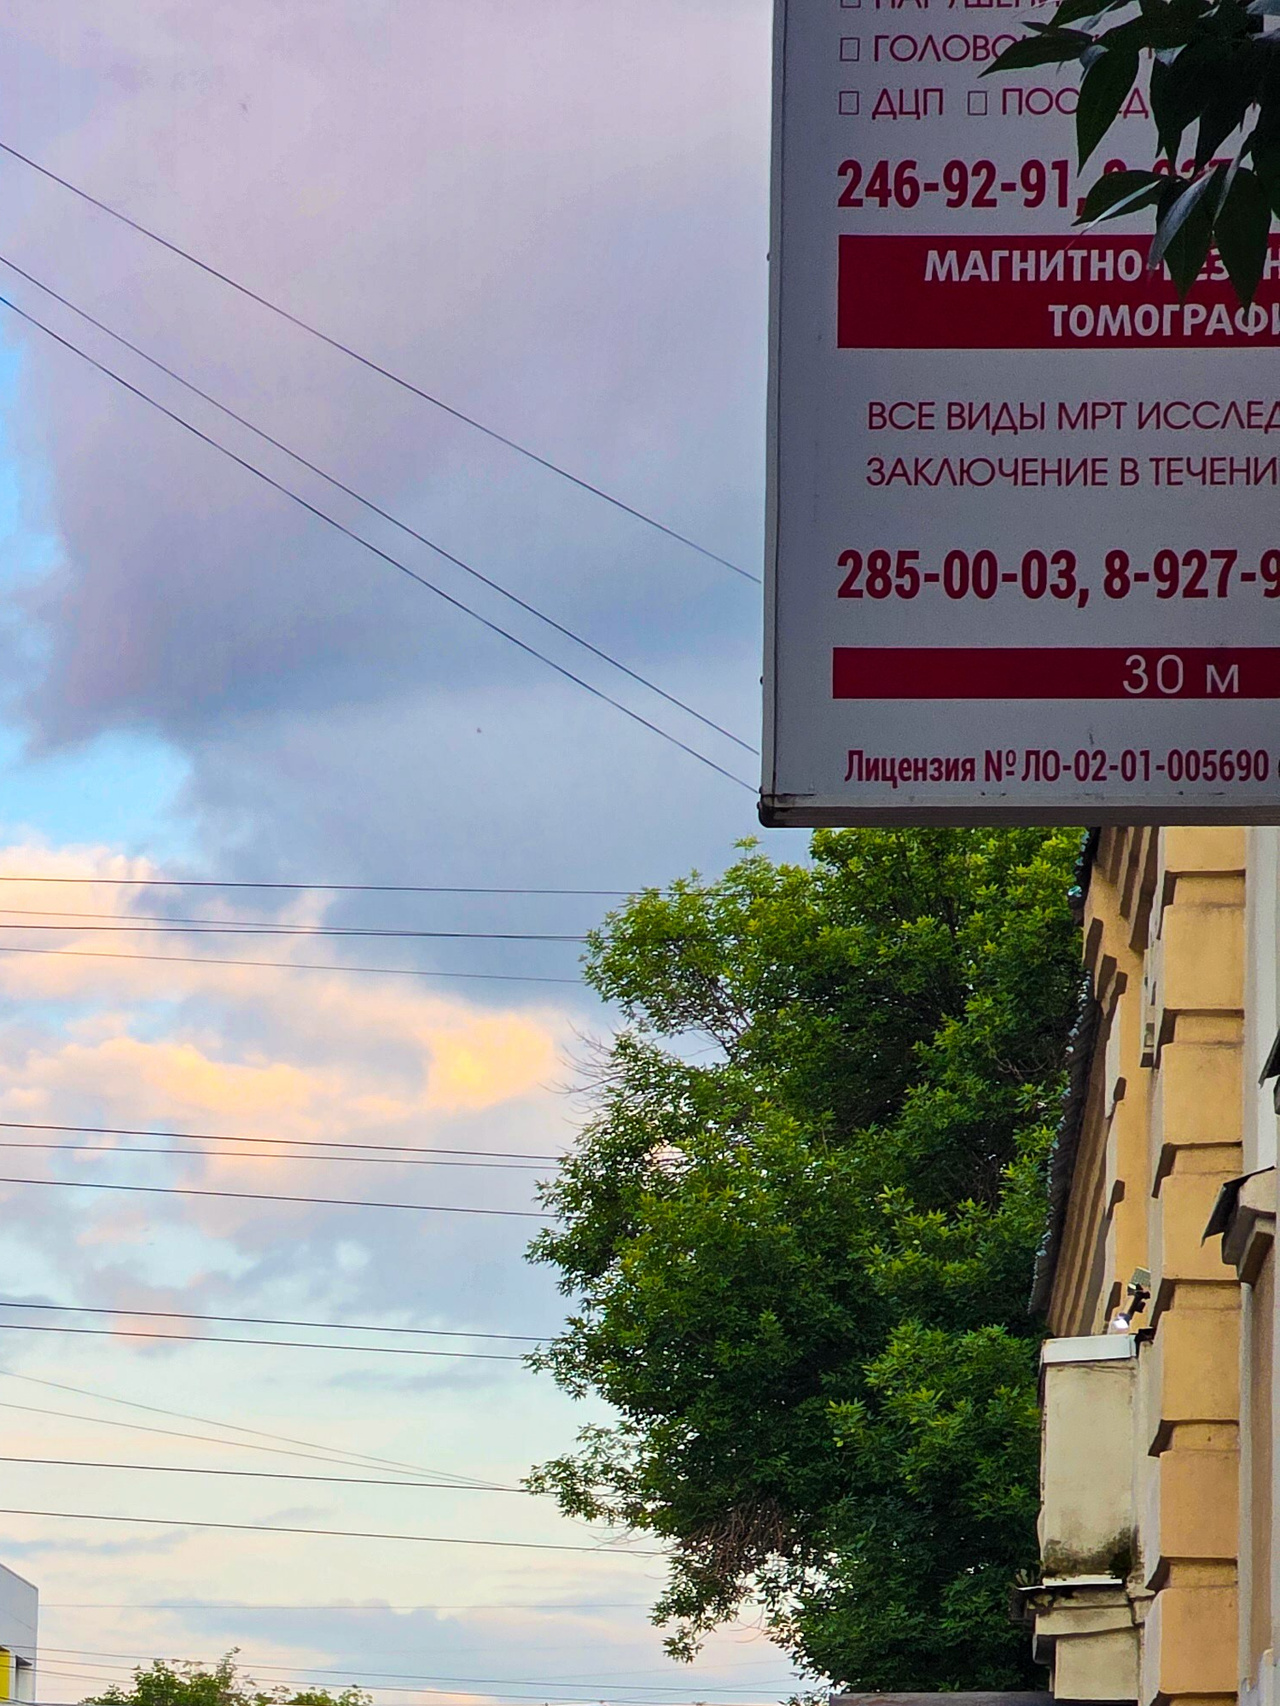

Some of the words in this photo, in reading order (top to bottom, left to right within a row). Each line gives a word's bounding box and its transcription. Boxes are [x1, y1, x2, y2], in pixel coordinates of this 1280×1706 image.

[872, 88, 944, 120] ДЦП
[868, 401, 935, 431] ВСЕ
[947, 401, 1045, 435] ВИДЫ
[1057, 401, 1127, 431] МРТ
[866, 456, 1108, 487] ЗАКЛЮЧЕНИЕ
[1120, 457, 1140, 485] В
[1122, 654, 1184, 694] 30
[844, 749, 976, 789] Лицензия
[1022, 749, 1269, 784] ЛО-02-01-005690
